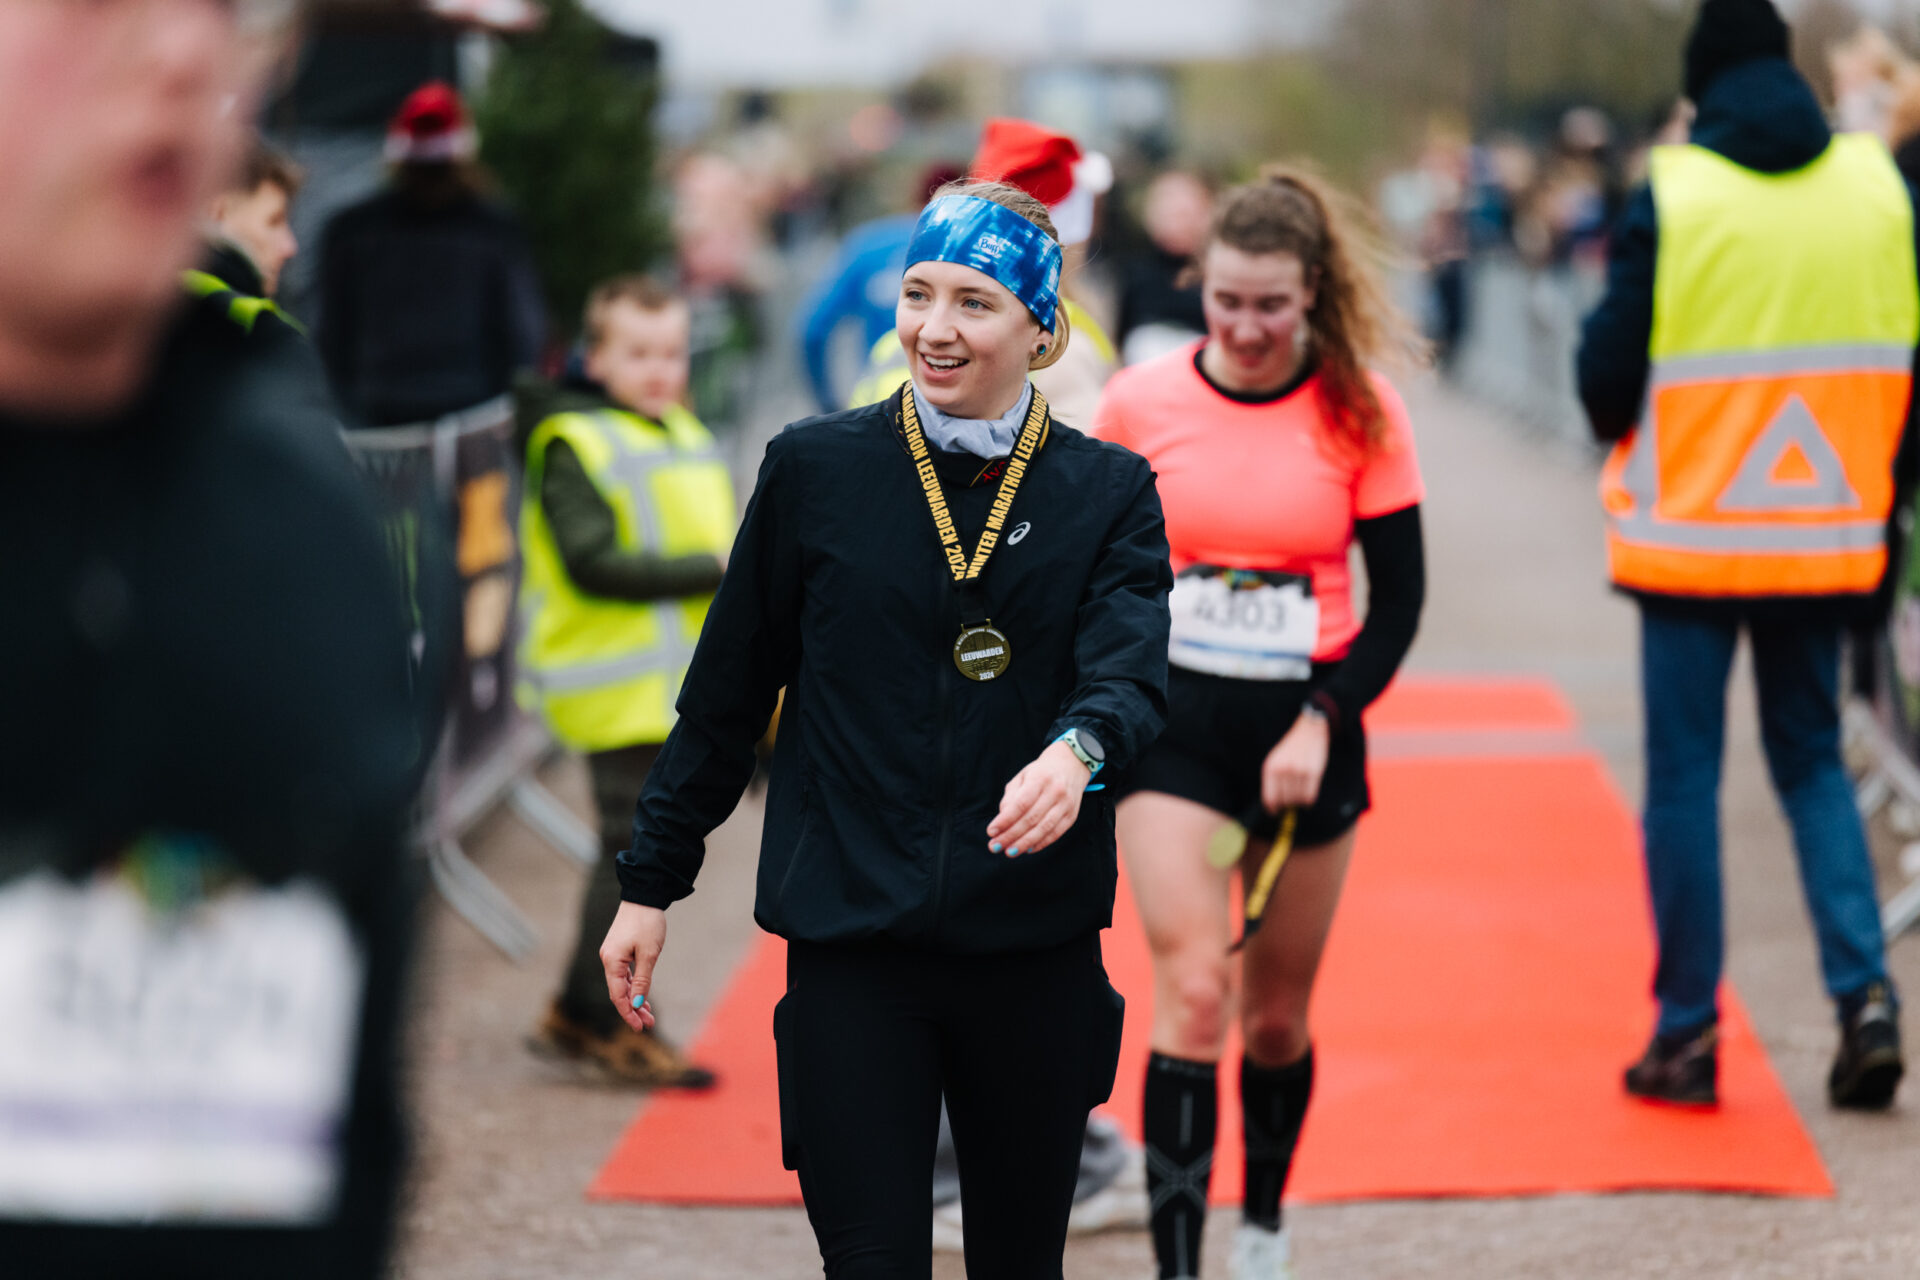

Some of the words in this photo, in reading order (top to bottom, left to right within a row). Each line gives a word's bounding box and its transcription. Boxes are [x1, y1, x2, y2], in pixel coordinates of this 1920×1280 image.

[902, 391, 929, 461] MARATHON
[916, 457, 959, 546] LEEUWARDEN
[965, 530, 1000, 579] WINTER
[985, 457, 1028, 531] MARATHON
[961, 646, 1003, 662] LEEUWARDEN
